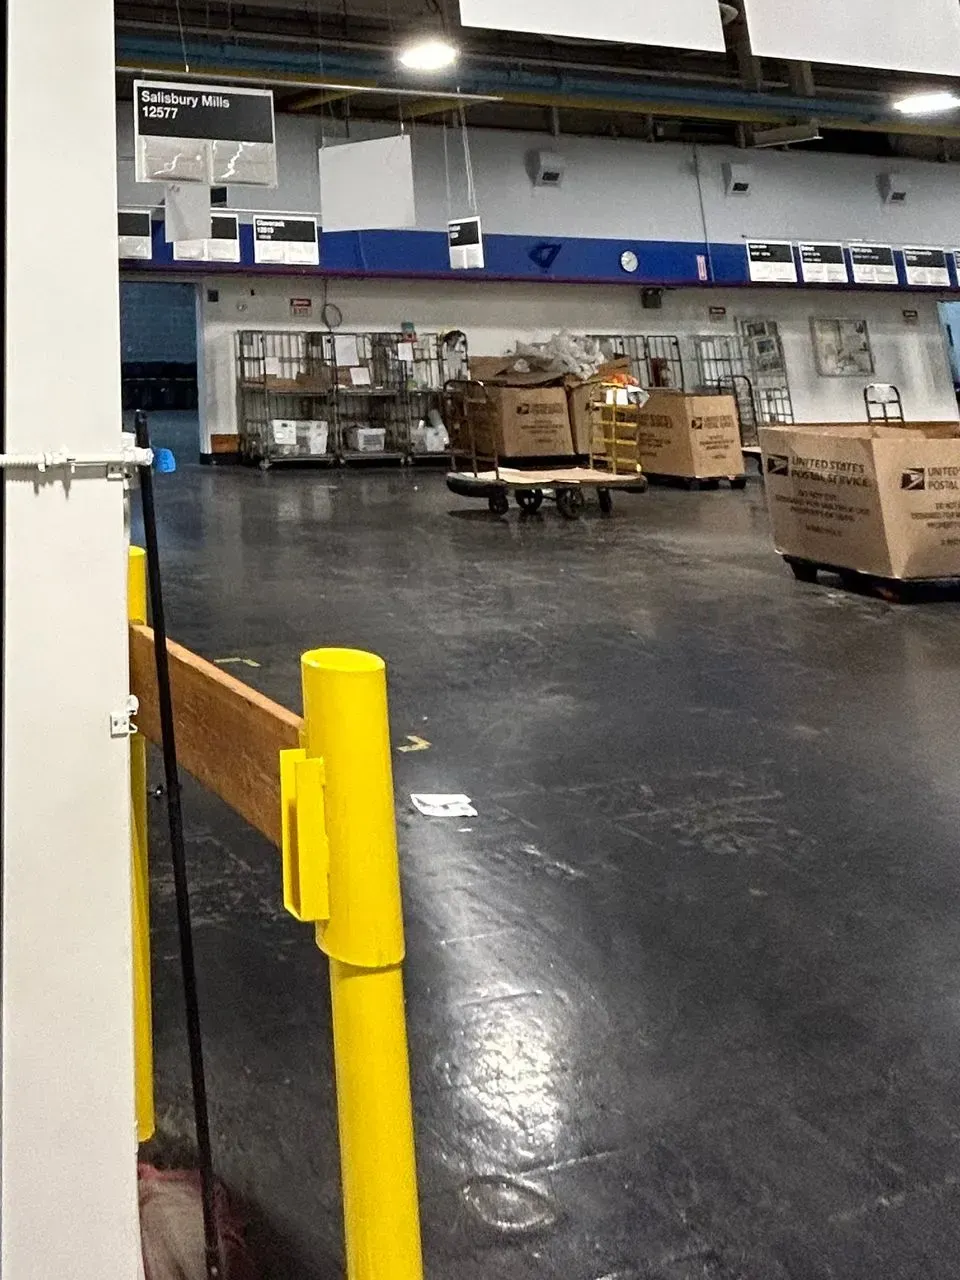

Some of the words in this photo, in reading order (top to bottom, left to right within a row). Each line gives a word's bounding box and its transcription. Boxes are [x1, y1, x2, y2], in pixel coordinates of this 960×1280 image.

[141, 90, 199, 108] Salisbury
[201, 95, 230, 108] Mills
[142, 106, 178, 119] 12577
[792, 456, 828, 469] UNITED
[829, 460, 865, 474] STATES
